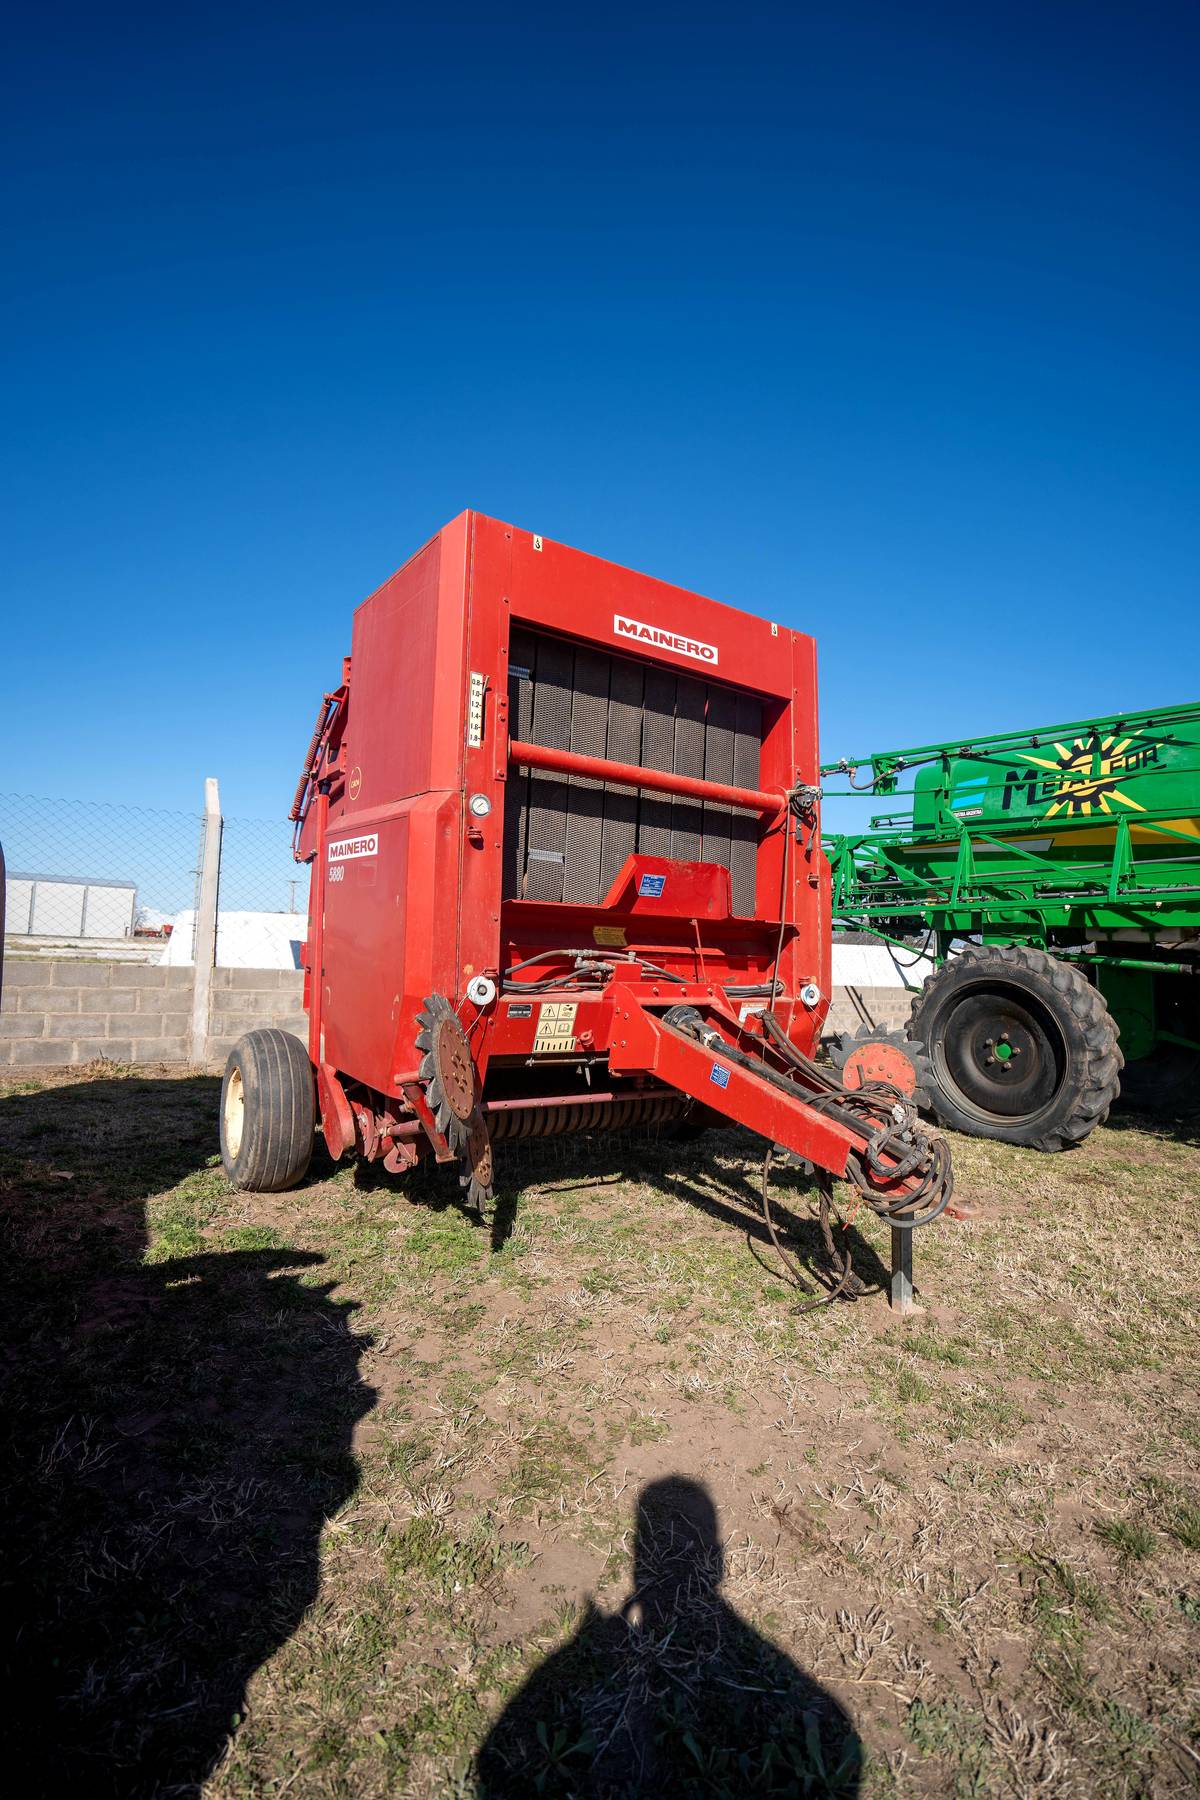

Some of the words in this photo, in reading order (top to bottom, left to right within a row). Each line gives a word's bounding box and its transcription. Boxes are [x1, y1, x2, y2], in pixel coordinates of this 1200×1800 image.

[618, 619, 715, 660] MAINERO
[330, 838, 376, 858] MAINERO
[329, 865, 345, 882] 5880
